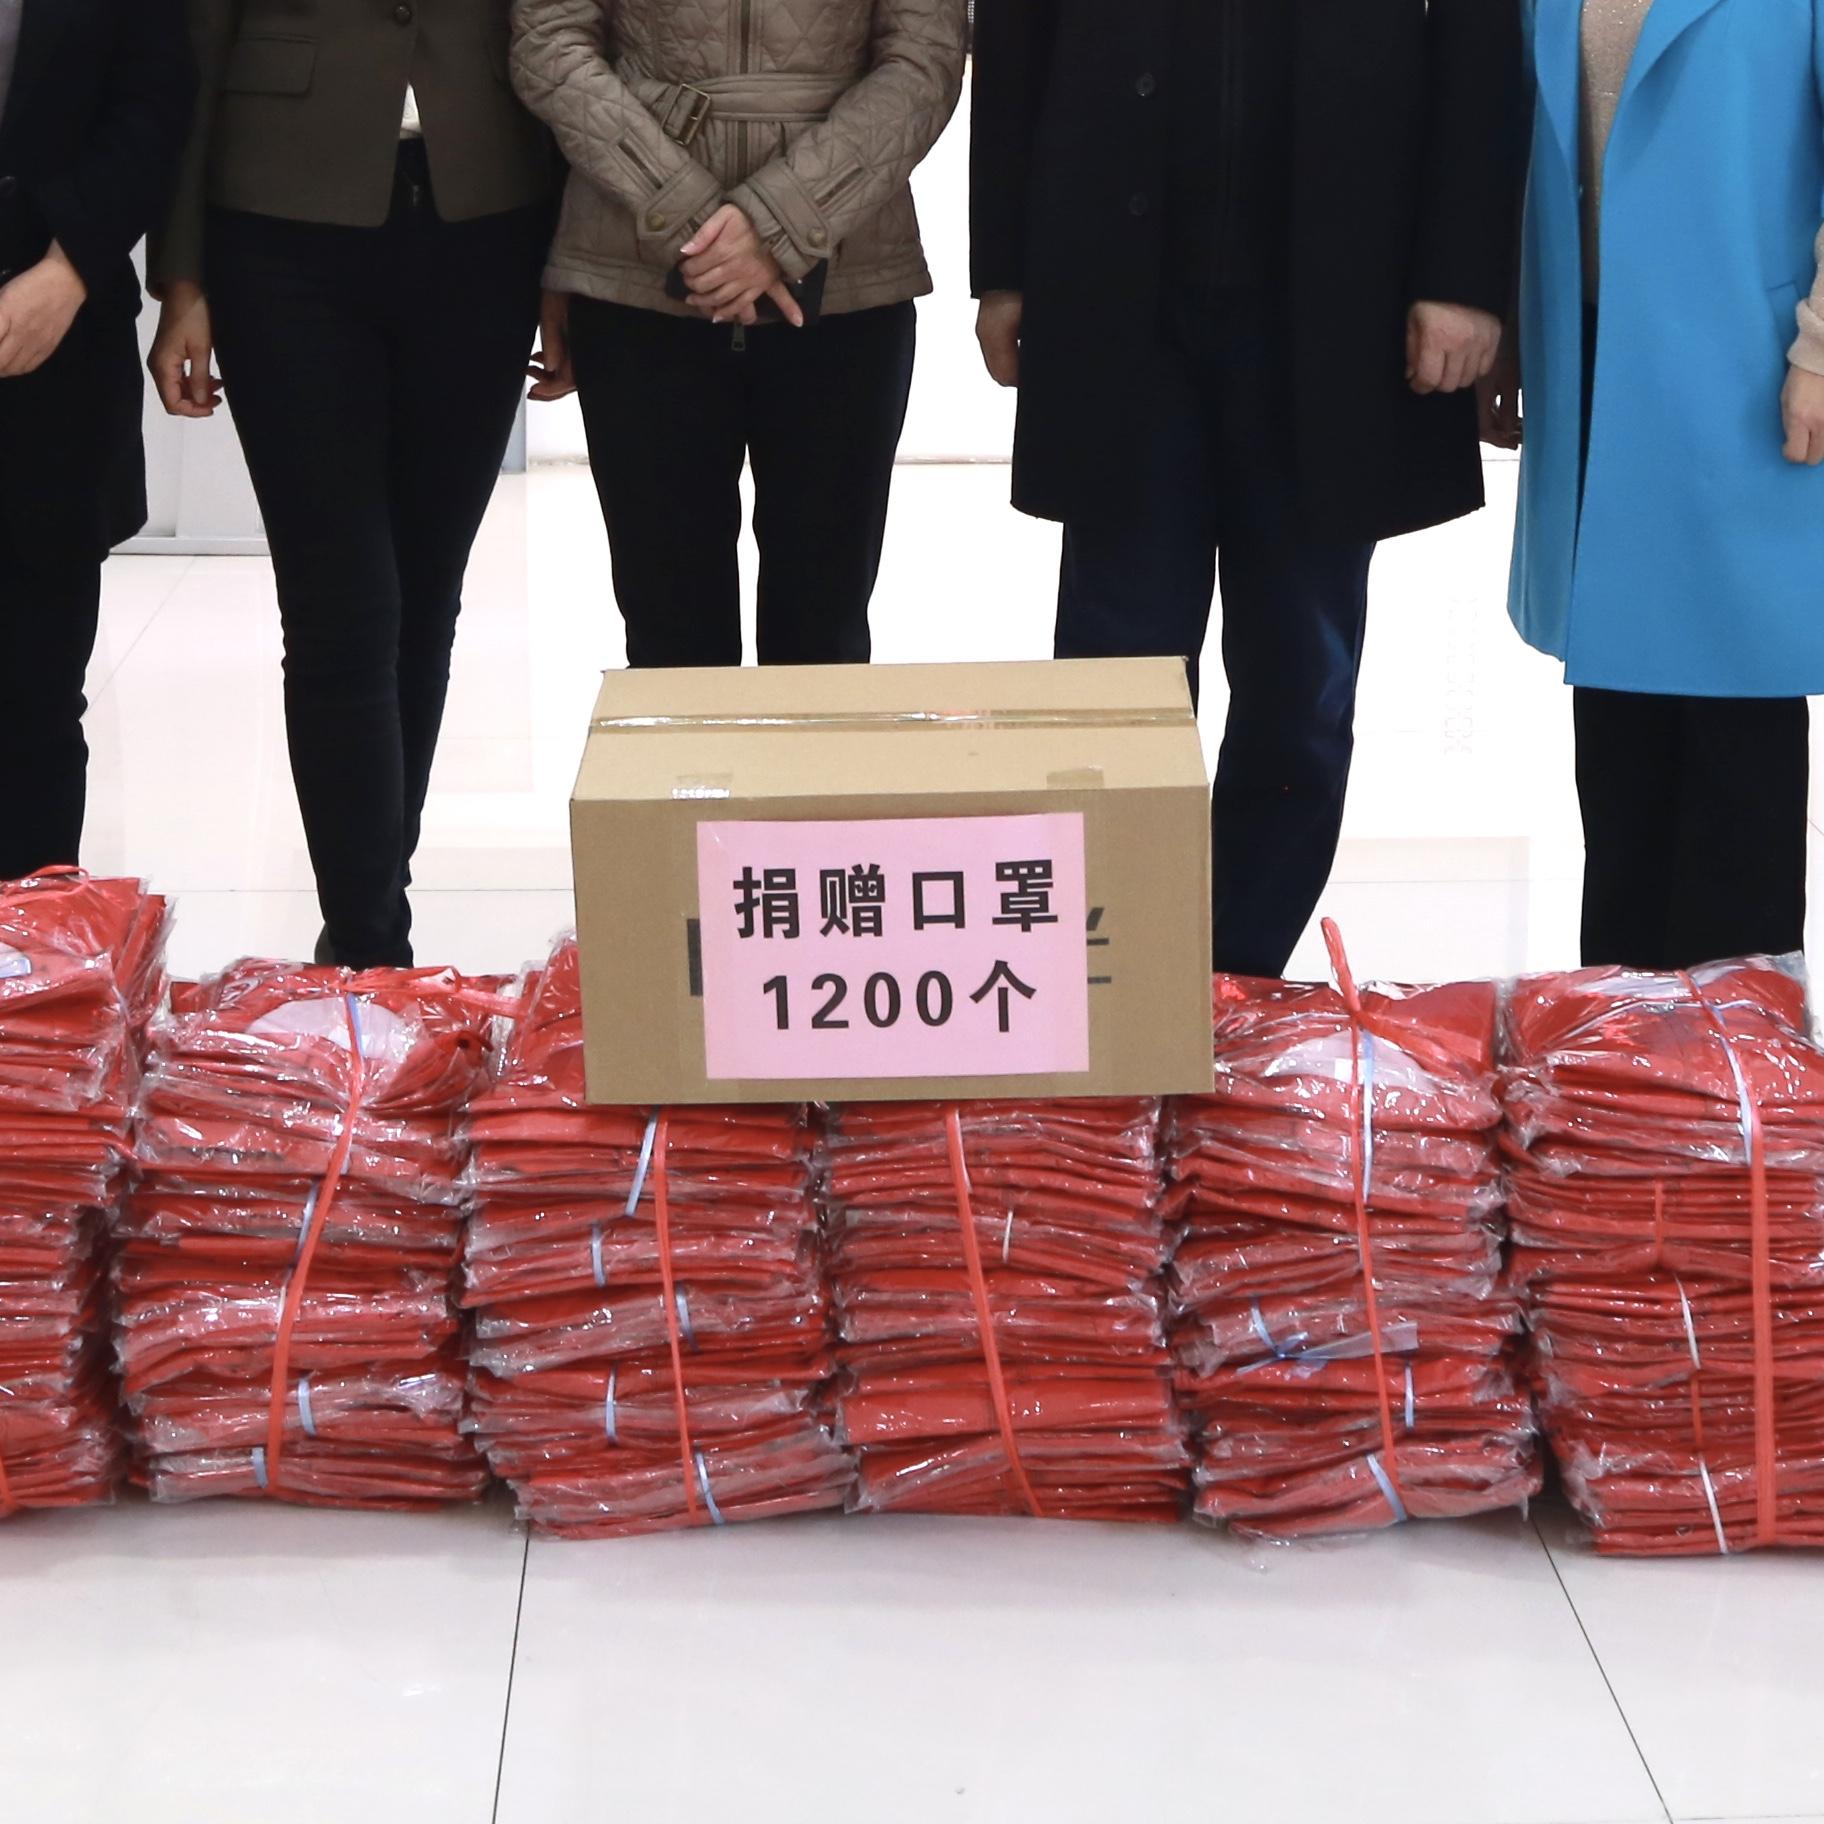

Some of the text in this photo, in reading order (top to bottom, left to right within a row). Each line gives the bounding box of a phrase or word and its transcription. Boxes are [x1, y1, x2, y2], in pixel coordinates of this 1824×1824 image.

[732, 857, 1059, 940] 捐赠口罩
[761, 959, 1037, 1032] 1200个
